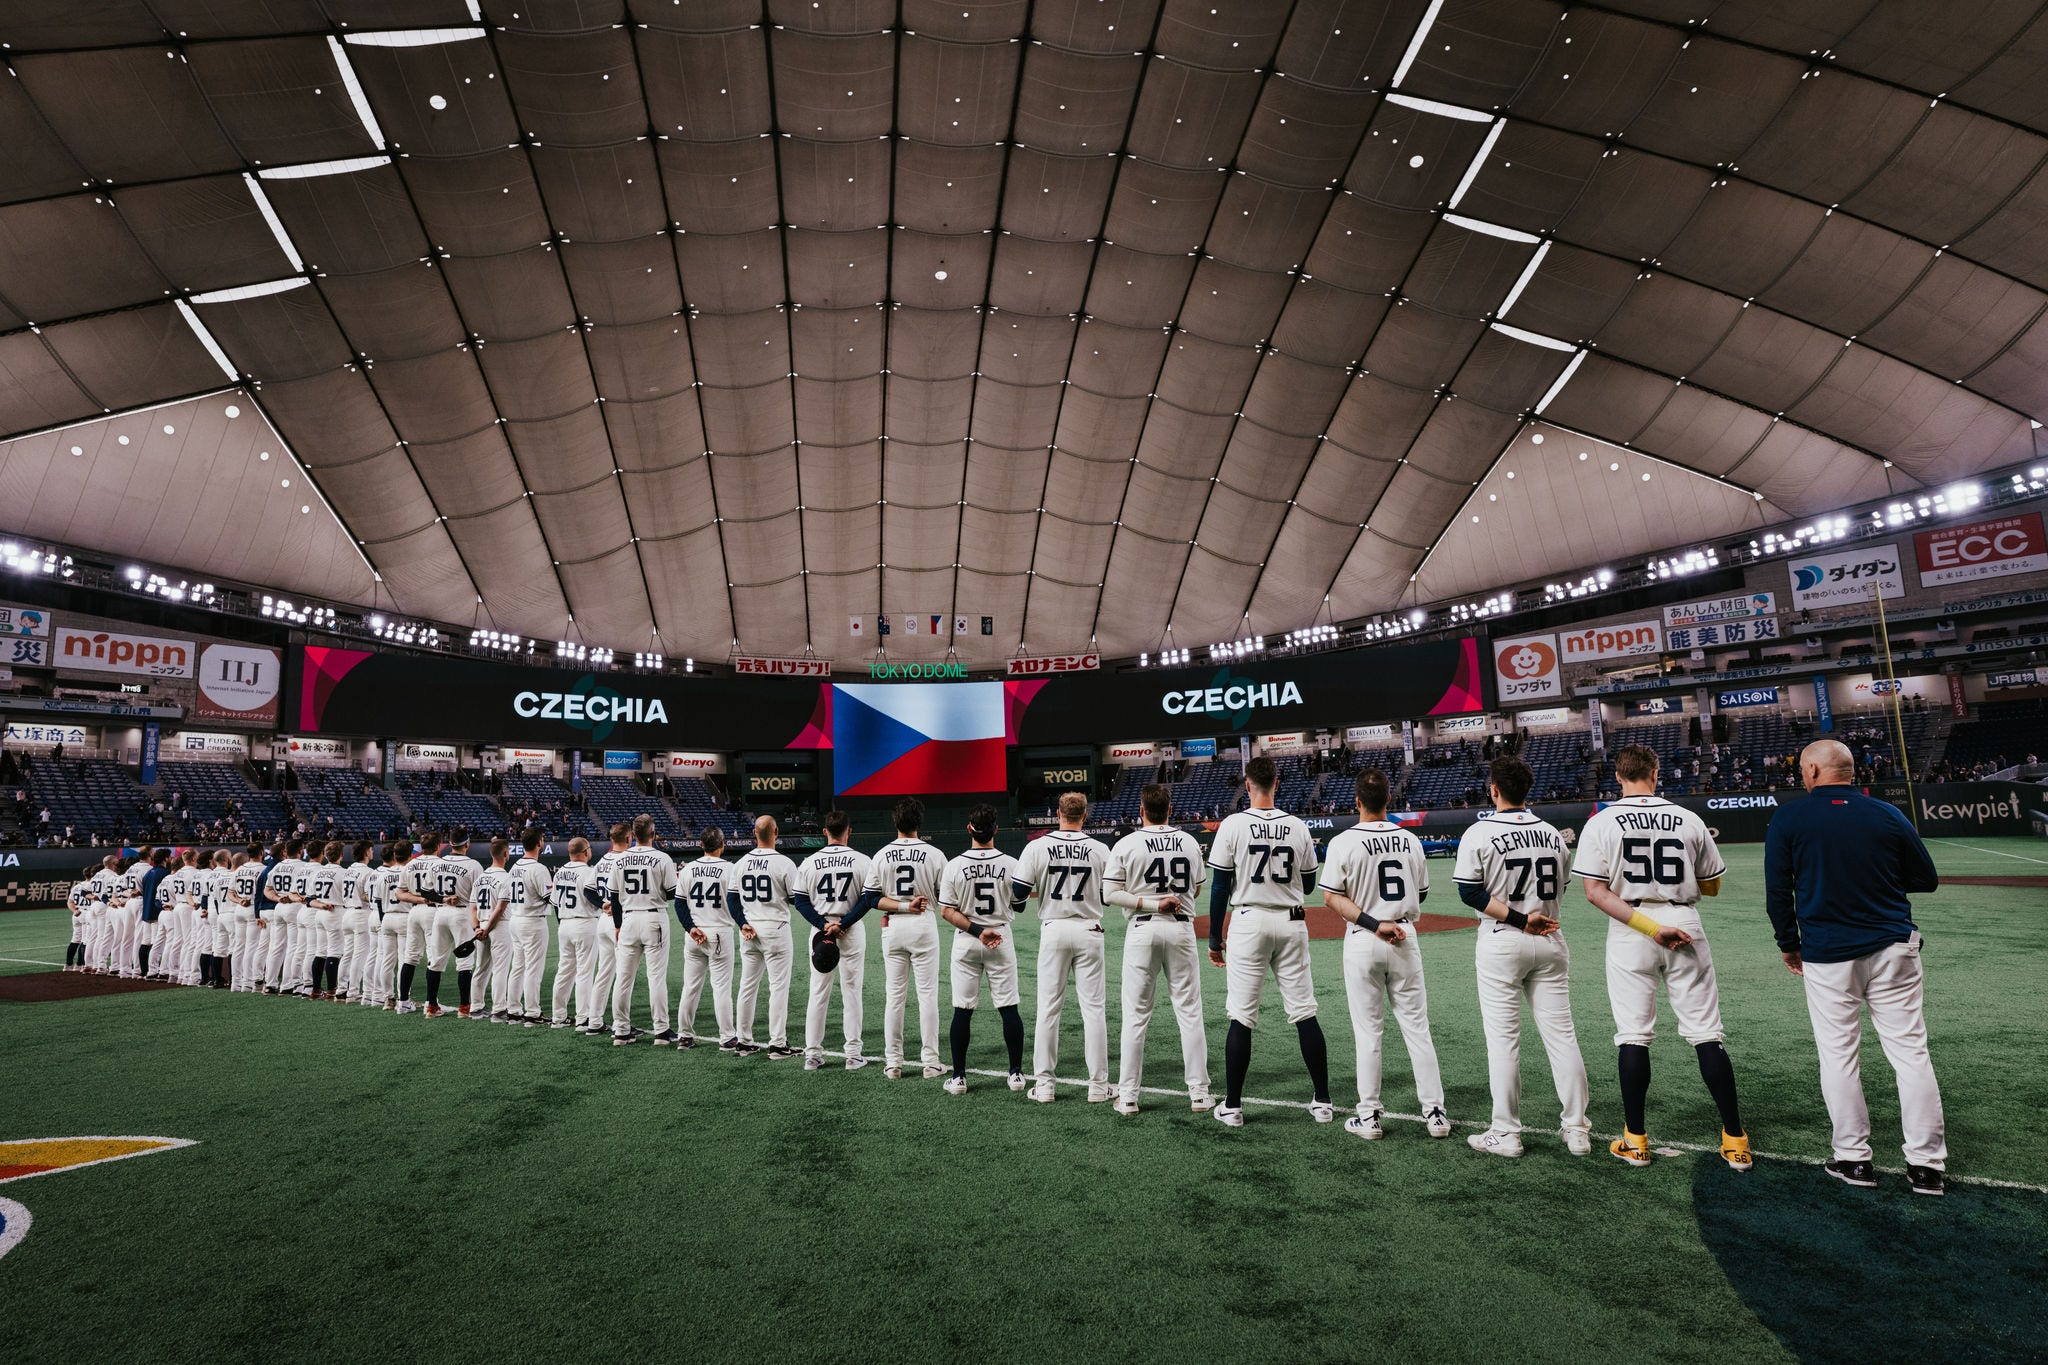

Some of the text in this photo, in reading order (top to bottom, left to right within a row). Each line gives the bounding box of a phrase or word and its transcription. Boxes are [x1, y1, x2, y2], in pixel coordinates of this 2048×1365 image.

[1930, 529, 2029, 568] ECC
[1829, 559, 1897, 582] ダイダン
[1670, 598, 1747, 619] あんしん財団
[1566, 627, 1656, 654] nippn
[1670, 619, 1777, 649] 能美防災
[64, 633, 186, 668] nippn
[1629, 644, 1657, 654] ニップン
[150, 666, 185, 676] ニップン
[219, 659, 262, 686] IIJ
[868, 663, 969, 679] TOKYO DOME
[1010, 655, 1097, 673] オロナミンC
[1506, 679, 1552, 695] シマダヤ
[514, 691, 669, 724] CZECHIA
[1162, 681, 1303, 715] CZECHIA
[1720, 690, 1773, 706] SAISON
[277, 746, 287, 754] 14
[423, 750, 454, 759] OMNIA
[486, 755, 491, 763] 4
[1112, 749, 1153, 758] Denyo
[672, 757, 715, 769] Denyo
[750, 777, 796, 791] RYOBI
[1044, 769, 1088, 784] RYOBI
[1707, 796, 1779, 809] CZECHIA
[1921, 795, 2010, 825] kewpie
[1249, 823, 1292, 841] CHLUP
[1615, 812, 1684, 832] PROKOP
[1145, 834, 1184, 853] MUŽÍK
[1361, 835, 1412, 856] VAVRA
[1491, 828, 1562, 855] ČERVINKA
[885, 849, 927, 864] PREJDA
[1047, 842, 1091, 862] MENŠÍK
[1622, 837, 1685, 885] 56
[431, 862, 468, 878] SCHNEIDER
[692, 866, 723, 879] TAKUBO
[747, 859, 769, 872] ZYMA
[813, 856, 856, 870] DERHAK
[962, 863, 1006, 881] ESCALA
[1249, 844, 1295, 884] 73
[126, 875, 136, 889] 15
[273, 875, 292, 892] 88
[437, 874, 457, 896] 13
[623, 868, 650, 895] 51
[896, 865, 915, 896] 2
[1048, 865, 1092, 902] 77
[1143, 856, 1191, 894] 49
[1377, 859, 1406, 902] 6
[1505, 857, 1558, 901] 78
[220, 886, 229, 903] 7
[236, 878, 255, 895] 38
[315, 881, 333, 899] 27
[511, 881, 525, 904] 12
[556, 884, 577, 909] 75
[690, 881, 722, 909] 44
[741, 874, 772, 903] 99
[816, 872, 854, 902] 47
[477, 888, 491, 910] 41
[974, 882, 996, 916] 5
